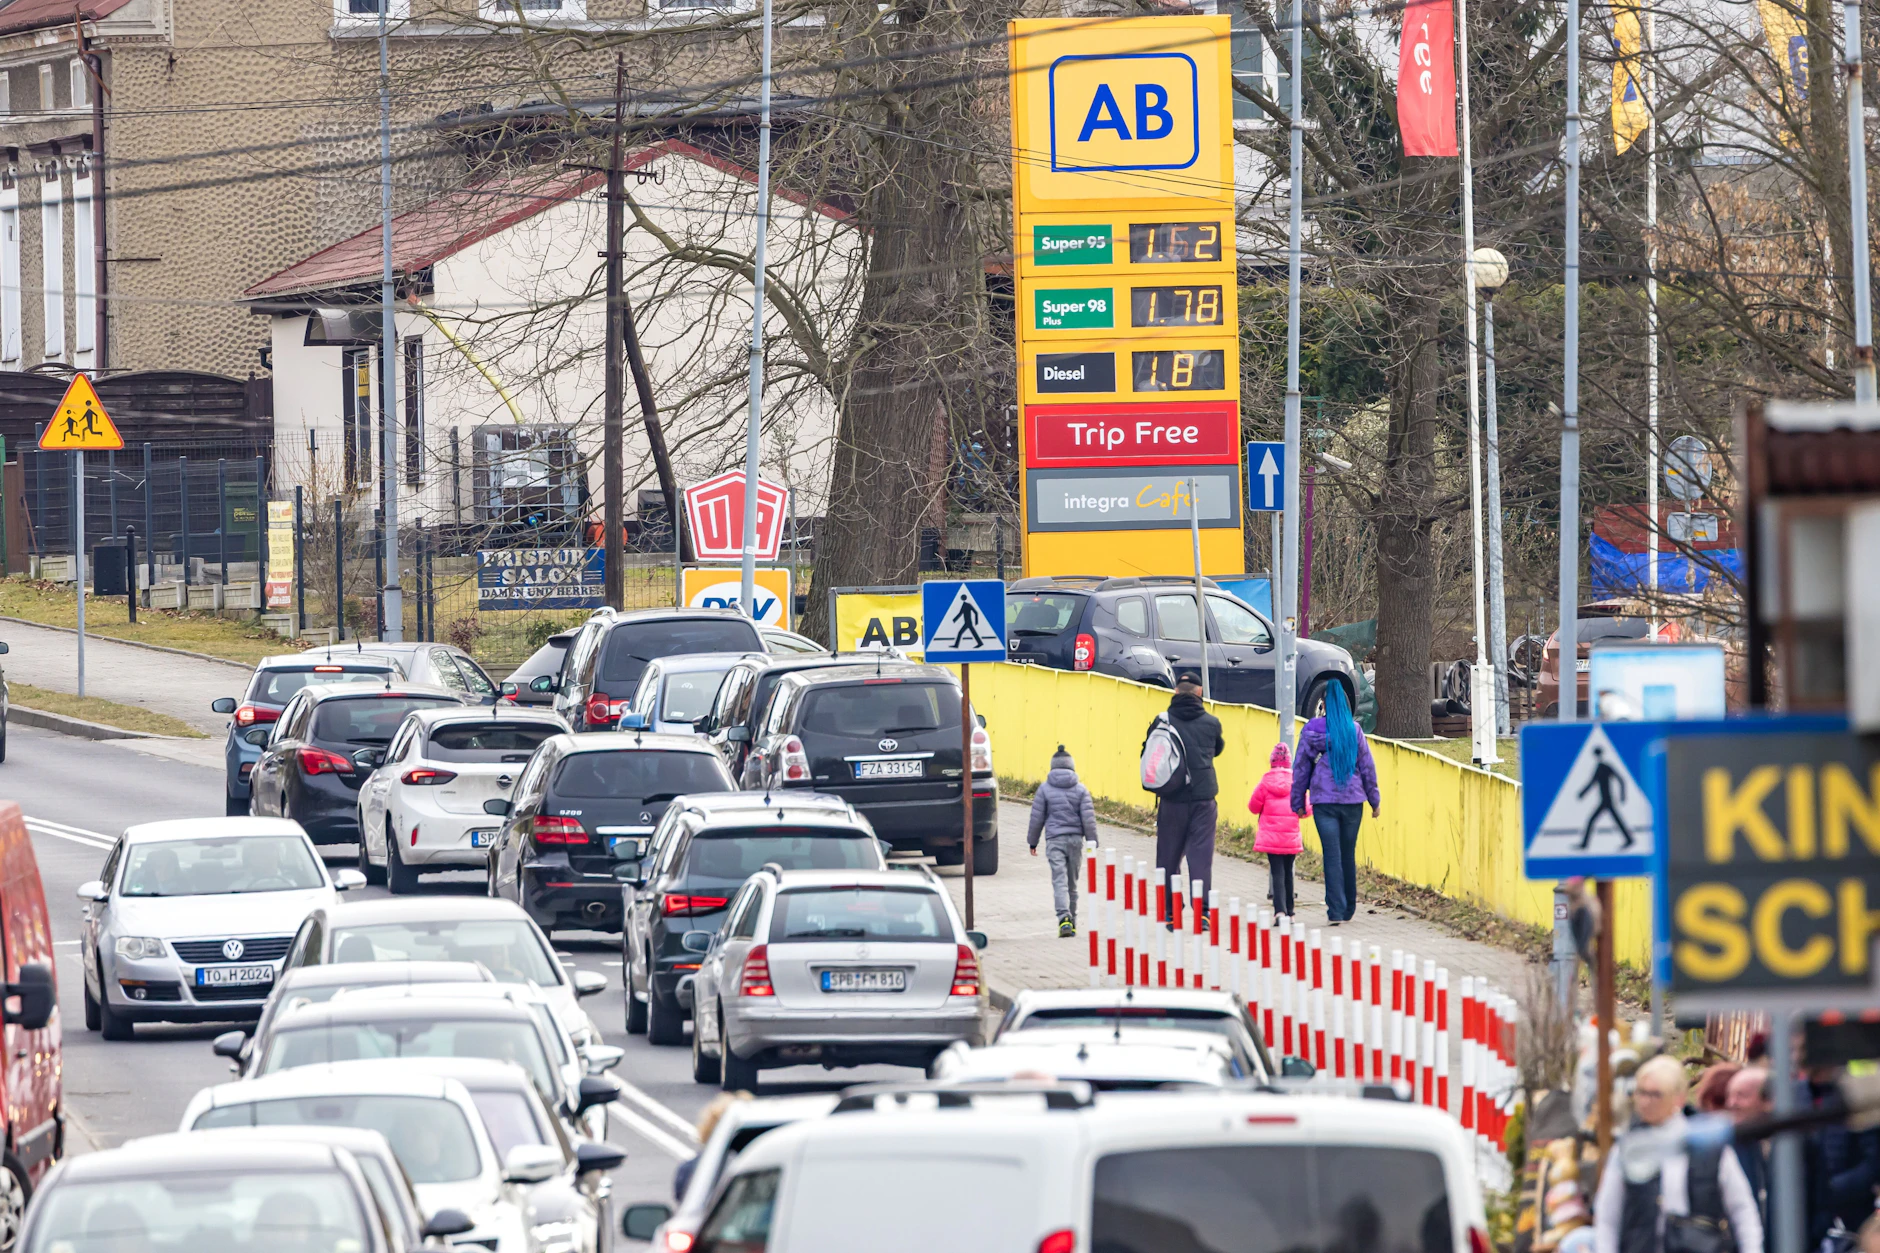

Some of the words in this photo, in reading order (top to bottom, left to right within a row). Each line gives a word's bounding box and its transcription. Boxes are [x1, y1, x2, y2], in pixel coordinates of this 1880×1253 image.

[1077, 83, 1174, 142] AB
[1041, 237, 1085, 253] Super
[1086, 235, 1106, 249] 95
[1042, 300, 1086, 316] Super
[1087, 299, 1107, 313] 98
[1148, 289, 1220, 323] 1.78
[1042, 317, 1062, 326] Plus
[1043, 364, 1085, 381] Diesel
[1150, 353, 1195, 388] 1.8
[1066, 421, 1125, 451] Trip
[1135, 421, 1200, 444] Free
[1064, 493, 1129, 513] integra
[481, 549, 588, 568] FRISEUR
[501, 567, 583, 585] SALON
[481, 588, 524, 599] DAMEN
[527, 586, 553, 597] UND
[861, 763, 883, 775] FZA
[886, 762, 921, 774] 33154
[206, 970, 221, 982] TO
[229, 969, 238, 981] H
[240, 968, 270, 980] 2024
[880, 973, 903, 986] 816
